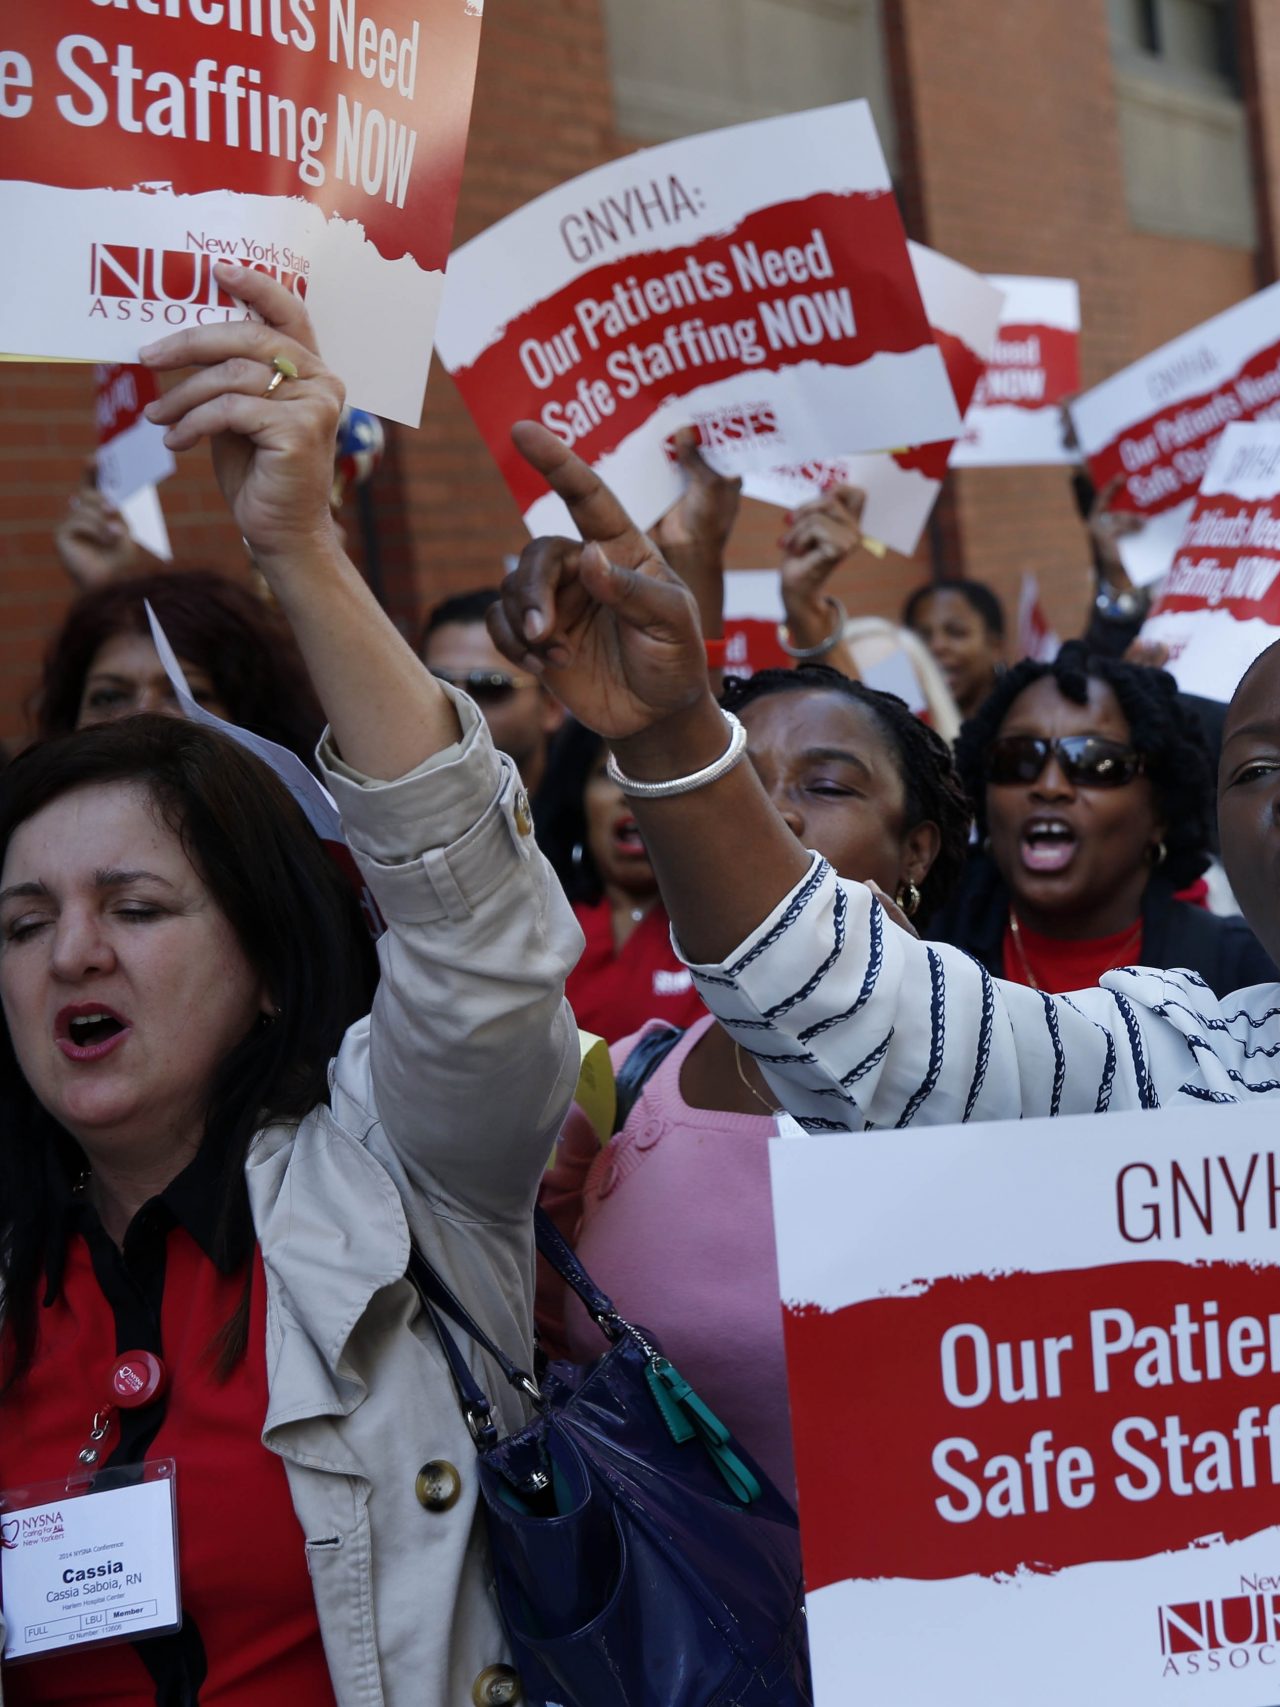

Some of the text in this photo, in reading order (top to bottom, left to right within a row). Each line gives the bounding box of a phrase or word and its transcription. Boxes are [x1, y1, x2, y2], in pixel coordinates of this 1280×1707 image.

[329, 0, 420, 101] Need
[56, 34, 327, 186] Staffing
[336, 94, 417, 209] NOW
[559, 174, 705, 264] GNYHA:
[90, 242, 309, 309] NUR
[186, 230, 310, 275] New York State
[88, 298, 258, 325] ASSOCIA
[518, 228, 834, 389] Our Patients Need
[541, 288, 857, 447] Safe Staffing NOW
[940, 1323, 1073, 1409] Our
[931, 1429, 1095, 1524] Safe
[22, 1511, 64, 1530] NYSNA
[46, 1572, 142, 1603] Cassia Saboia, RN
[62, 1560, 124, 1584] Cassia
[28, 1626, 48, 1637] FULL
[85, 1614, 103, 1625] LBU
[113, 1607, 144, 1618] Member
